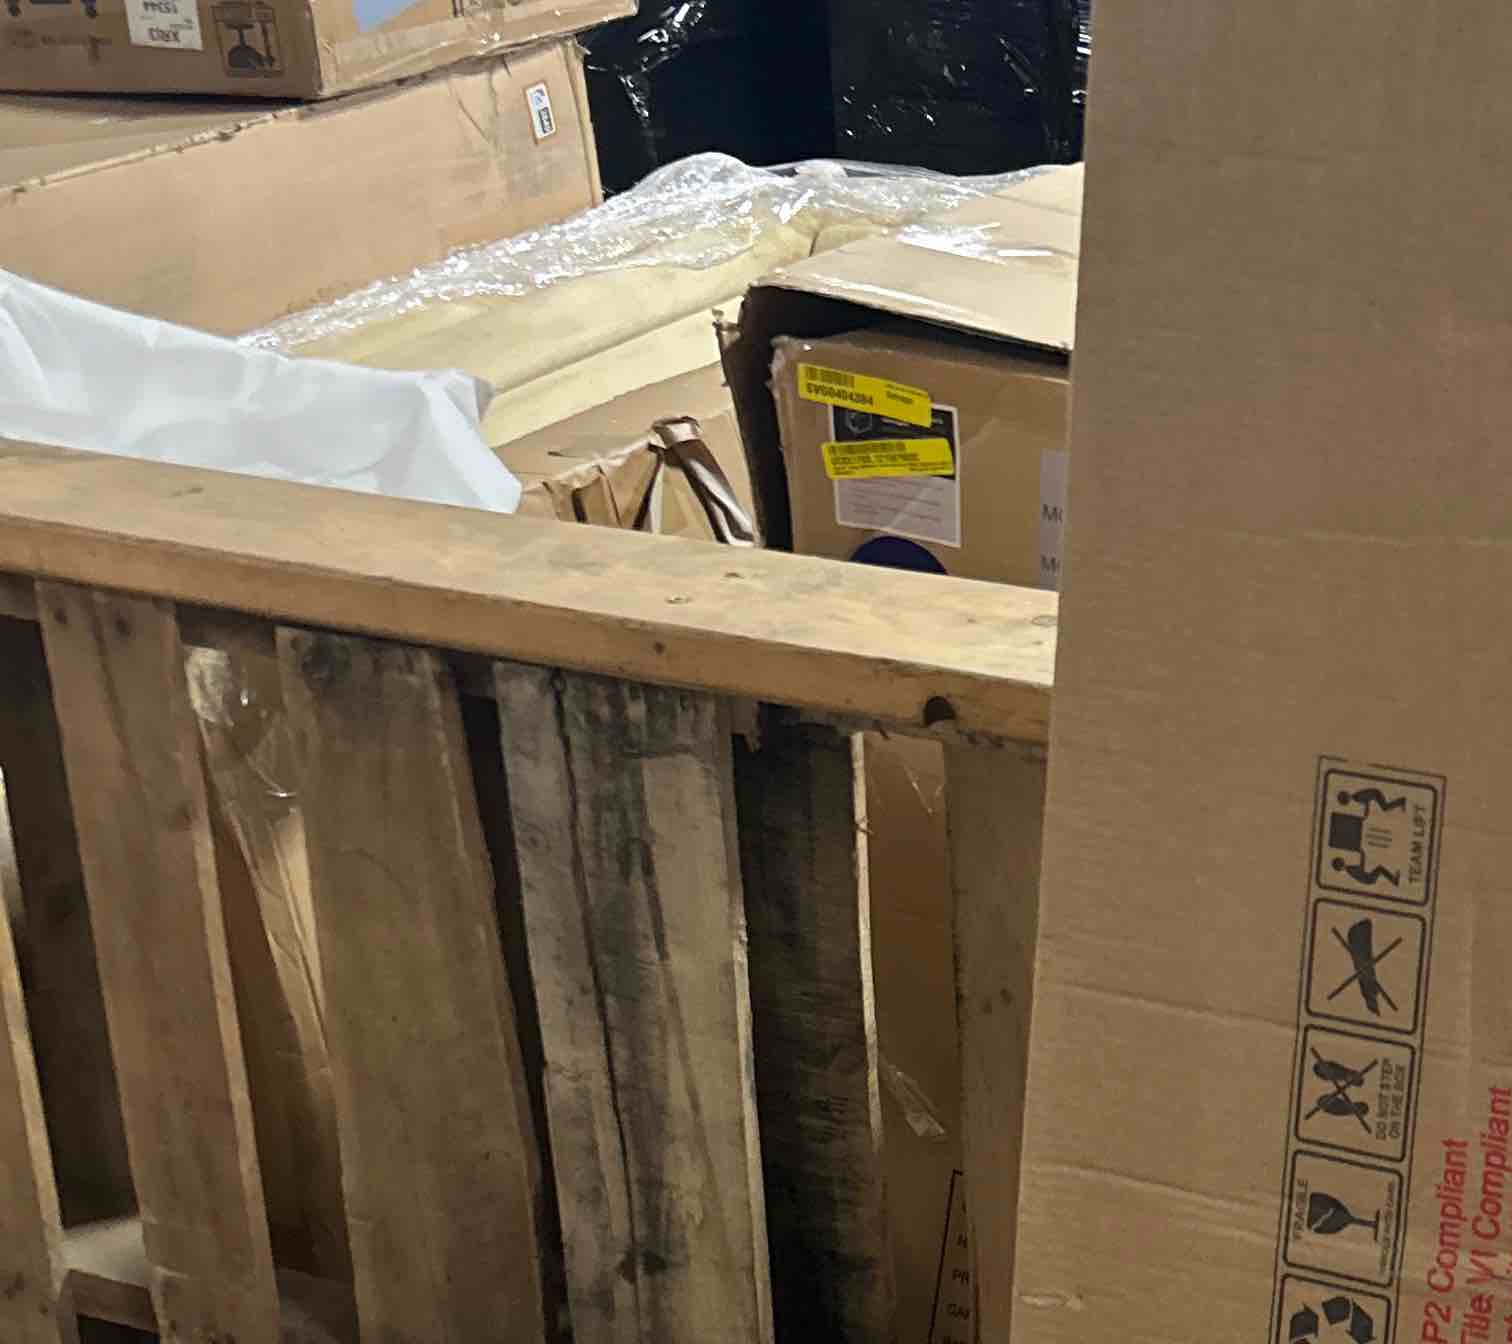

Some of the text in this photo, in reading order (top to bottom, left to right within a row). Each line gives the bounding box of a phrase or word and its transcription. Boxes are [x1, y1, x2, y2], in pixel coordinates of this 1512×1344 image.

[1408, 804, 1426, 884] TEAM LIFT
[1376, 1059, 1392, 1140] DO NOT STEP
[1390, 1121, 1400, 1139] ON
[1391, 1094, 1402, 1118] THE
[1472, 1085, 1512, 1241] Compliant
[1293, 1178, 1308, 1241] FRAGILE
[1427, 1138, 1468, 1294] Compliant
[1467, 1248, 1499, 1285] VI
[1422, 1301, 1452, 1344] P2
